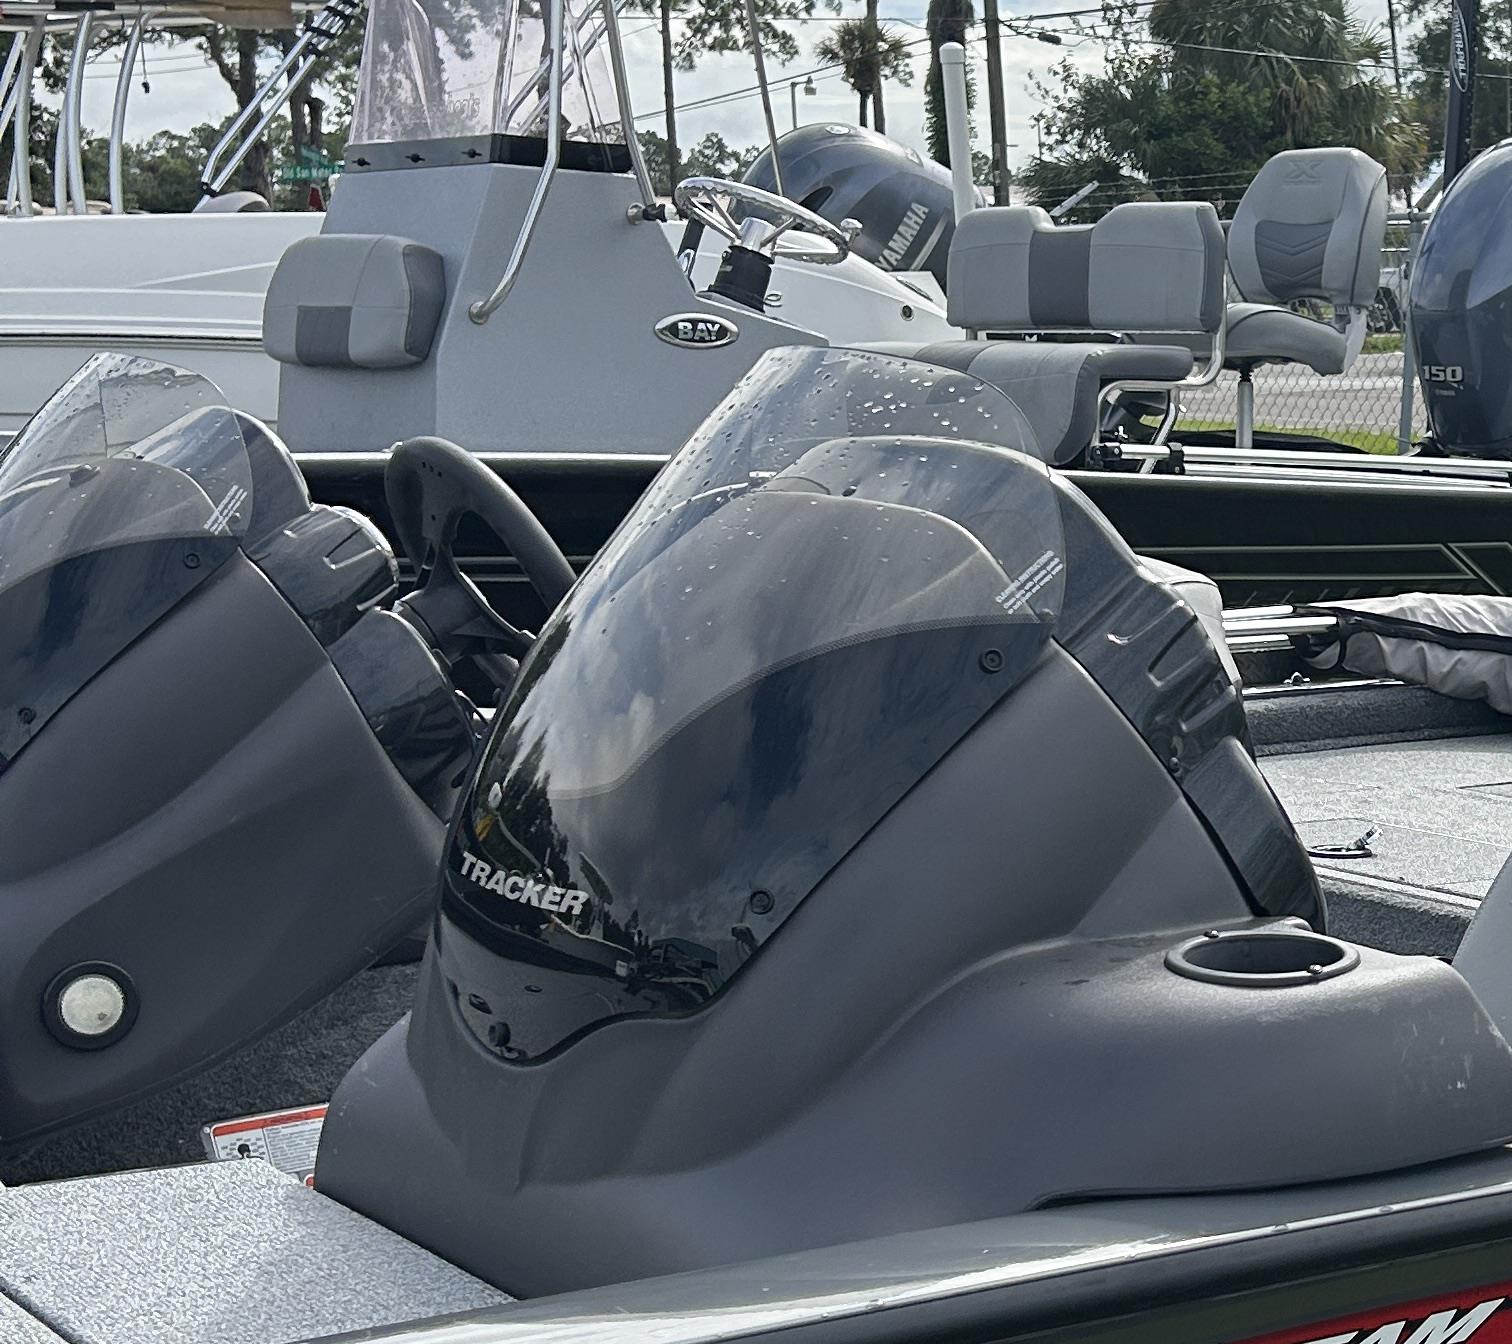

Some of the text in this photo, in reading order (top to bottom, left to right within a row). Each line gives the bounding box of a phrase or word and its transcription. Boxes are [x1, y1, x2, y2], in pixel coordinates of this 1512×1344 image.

[875, 202, 929, 271] YAMAHA
[677, 321, 721, 341] BAY
[1422, 364, 1463, 382] 150
[460, 850, 590, 915] TRACKER
